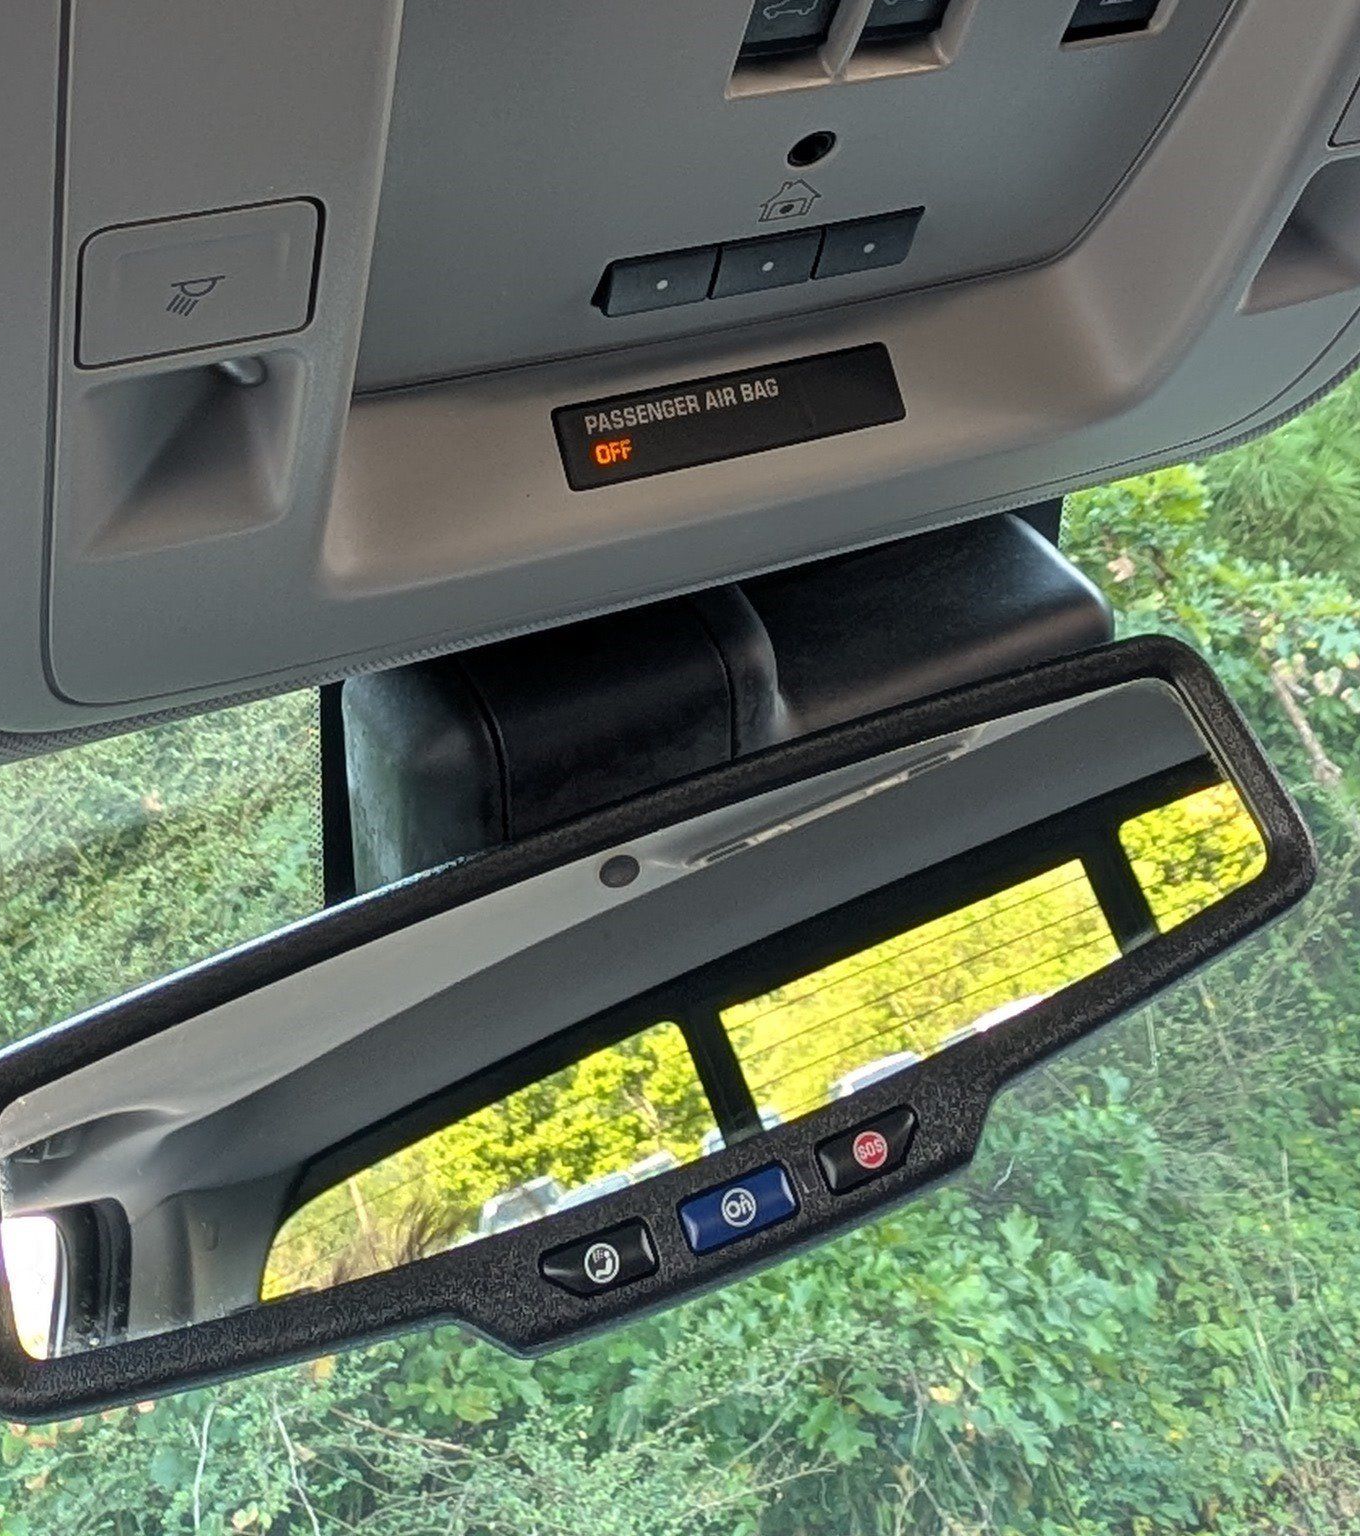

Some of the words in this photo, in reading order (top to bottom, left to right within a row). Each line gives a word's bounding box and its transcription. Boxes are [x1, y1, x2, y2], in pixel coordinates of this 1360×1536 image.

[584, 395, 700, 435] PASSENGER
[705, 386, 737, 411] AIR
[740, 378, 779, 402] BAG
[594, 438, 633, 465] OFF
[857, 1138, 885, 1160] SOS
